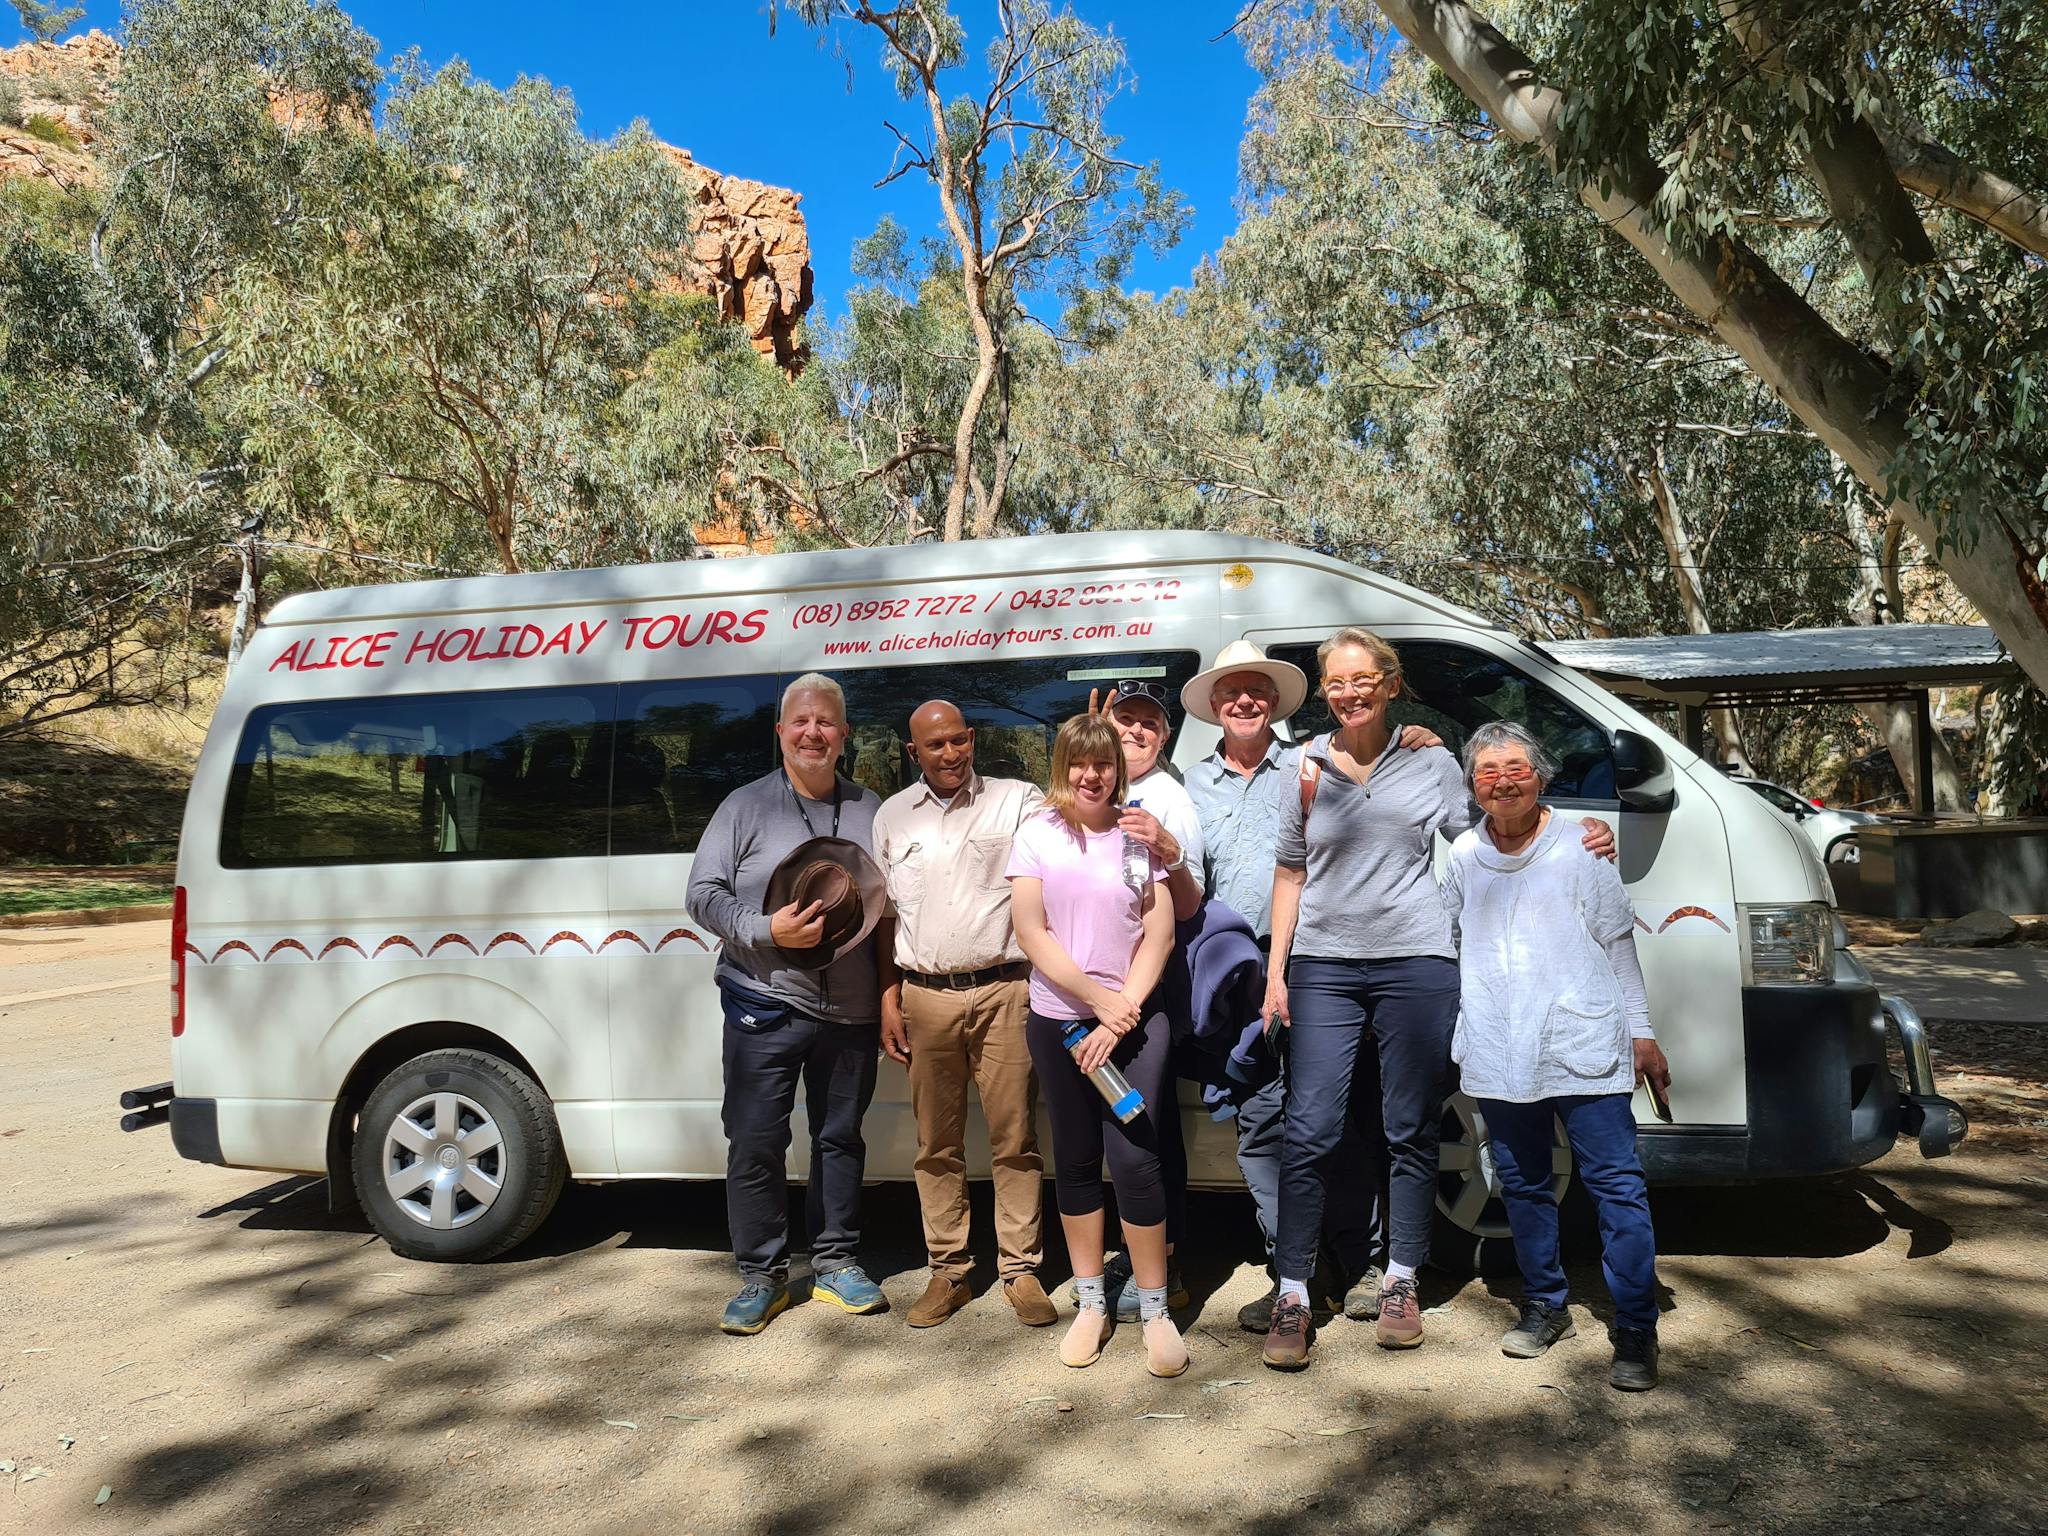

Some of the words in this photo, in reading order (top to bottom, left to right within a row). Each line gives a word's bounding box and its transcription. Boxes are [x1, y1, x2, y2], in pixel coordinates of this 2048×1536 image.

[793, 604, 842, 629] (08)
[847, 598, 909, 622] 8952
[916, 594, 979, 617] 7272
[984, 591, 1003, 613] /
[1009, 587, 1076, 611] 0432
[269, 631, 399, 672] ALICE
[405, 620, 608, 664] HOLIDAY
[623, 608, 768, 651] TOURS
